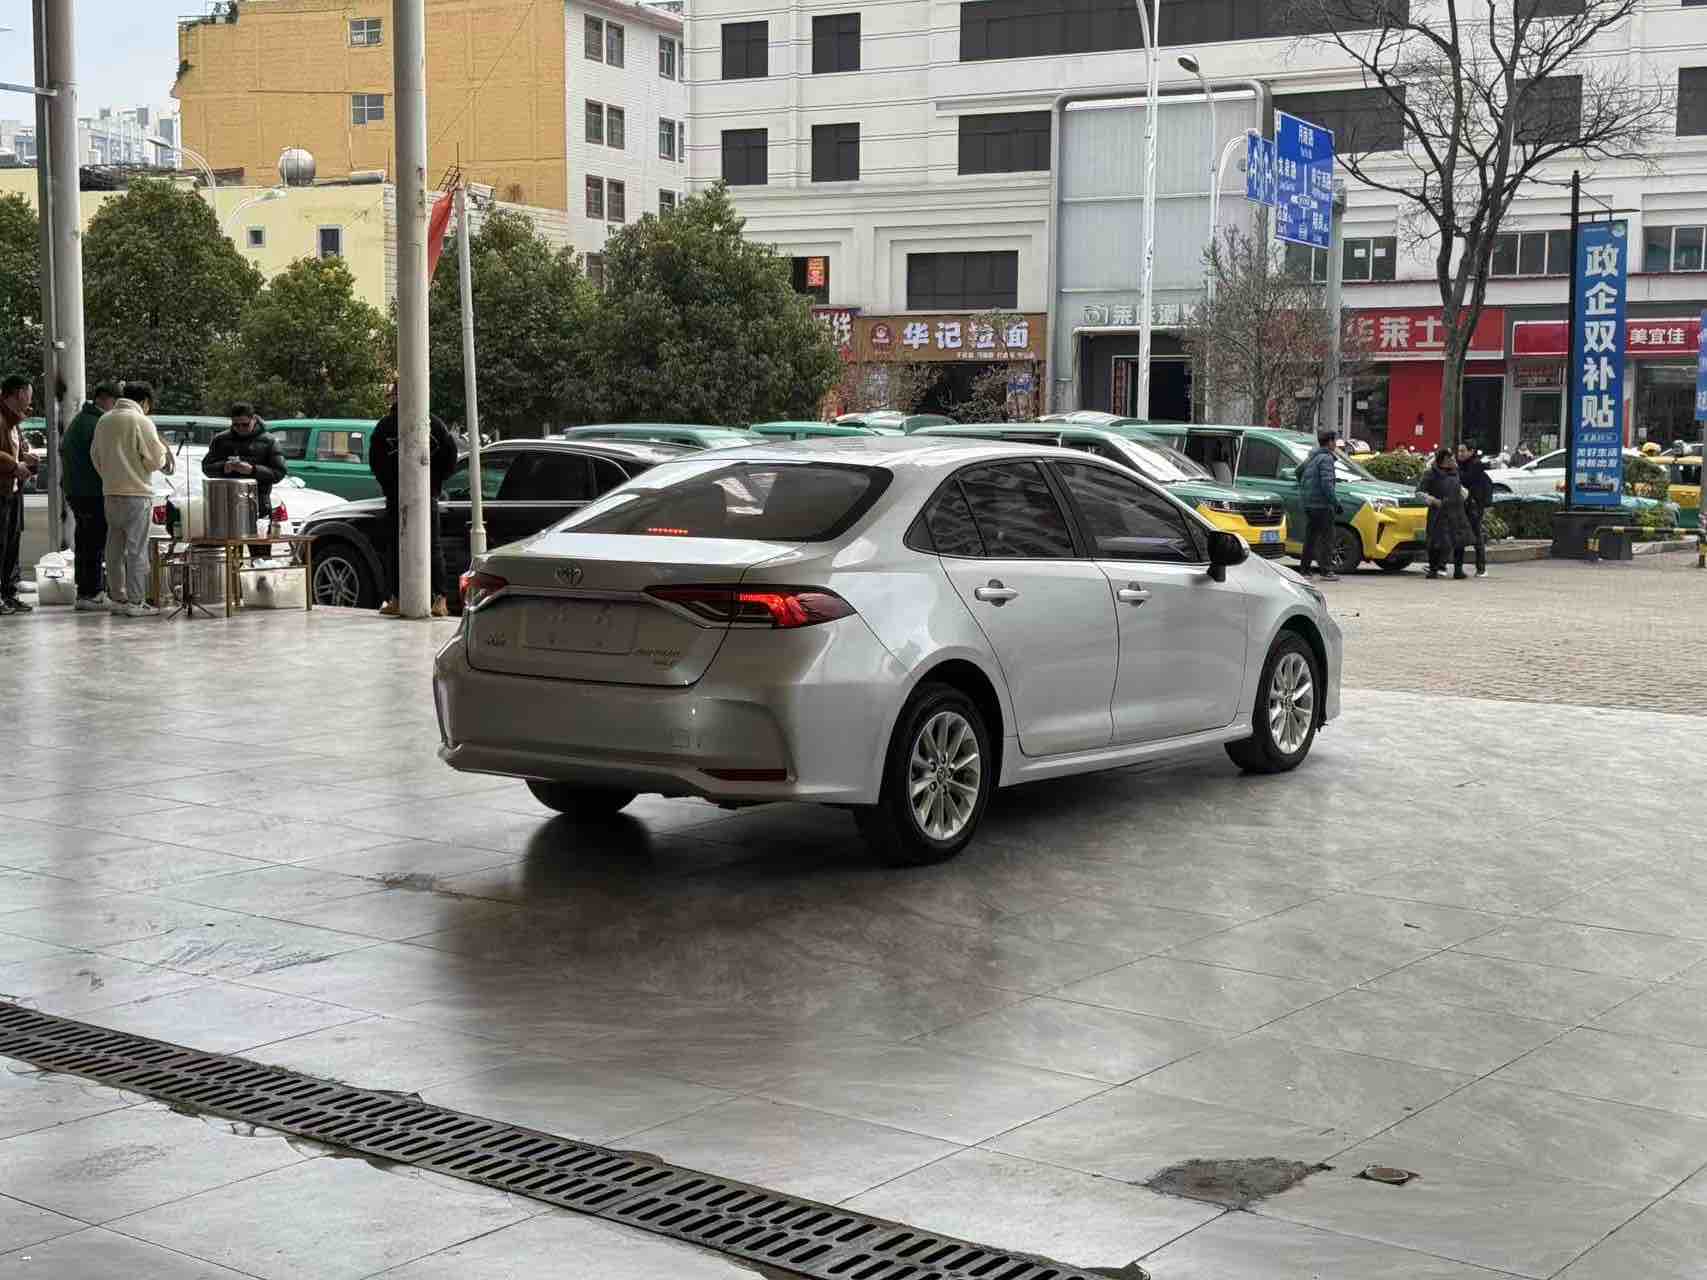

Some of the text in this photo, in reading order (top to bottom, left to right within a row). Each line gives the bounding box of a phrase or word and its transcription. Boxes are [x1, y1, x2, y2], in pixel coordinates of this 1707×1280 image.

[1581, 243, 1619, 429] 政企双补贴
[1629, 326, 1686, 345] 美宜佳
